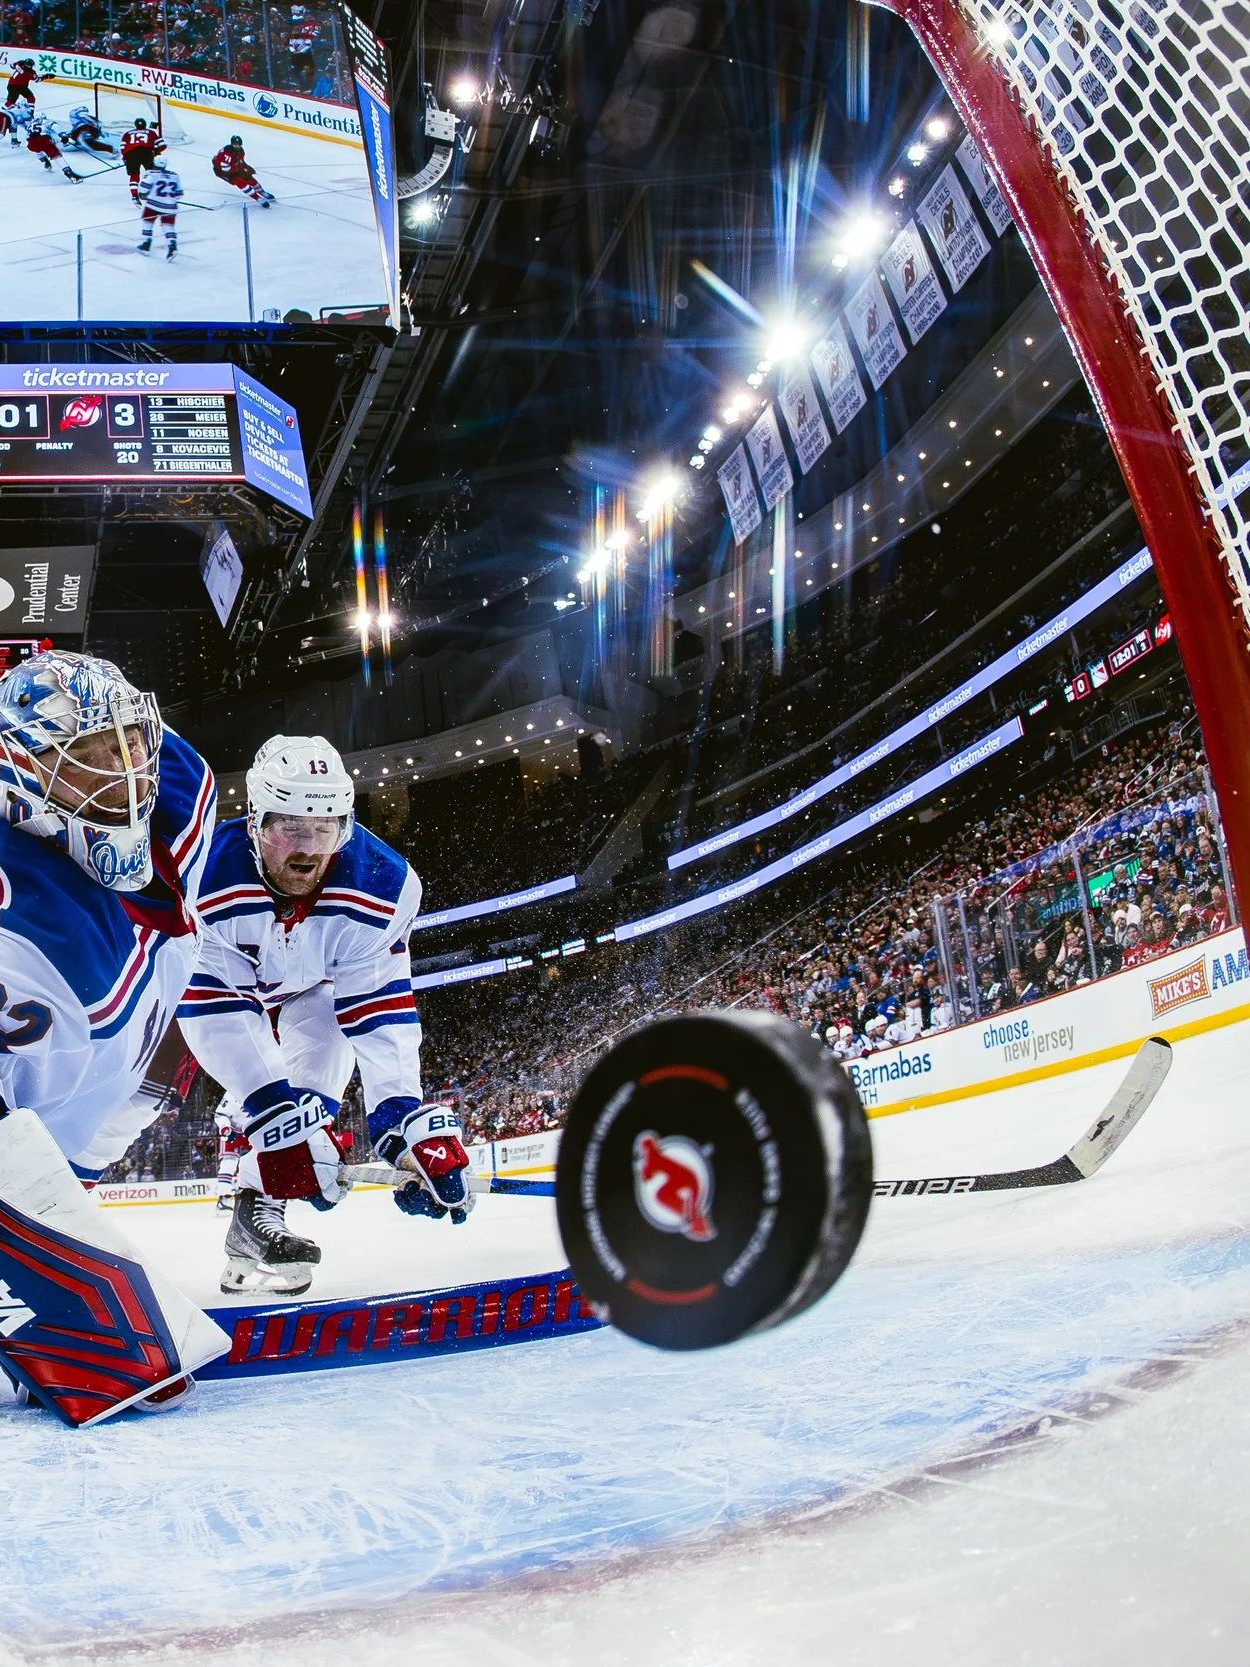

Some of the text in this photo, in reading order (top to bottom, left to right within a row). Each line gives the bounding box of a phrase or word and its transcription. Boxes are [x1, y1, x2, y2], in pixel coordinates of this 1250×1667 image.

[60, 58, 134, 85] Citizens
[283, 103, 362, 136] Prudentia
[129, 132, 148, 145] 13
[371, 102, 388, 200] ticketmaster
[154, 180, 177, 197] 23
[22, 368, 169, 387] ticketmaster
[150, 396, 225, 407] 13 HISCHIER
[239, 381, 282, 416] ticketmaster
[115, 403, 135, 428] 3
[195, 412, 227, 423] MEIER
[243, 409, 259, 426] BUY
[267, 424, 285, 444] SELL
[36, 442, 73, 450] PENALTY
[113, 442, 142, 450] SHOTS
[152, 428, 229, 438] 11 NOESEN
[116, 451, 139, 465] 20
[172, 444, 230, 455] KOVACEVIC
[246, 432, 289, 467] TICKETS AT
[154, 460, 232, 472] 71 SIEGENTHALER
[247, 444, 305, 488] TICKETMASTER
[1119, 552, 1152, 586] ticketm
[21, 562, 50, 624] Prudential
[54, 574, 81, 612] Center
[1016, 617, 1068, 661] ticketmaster
[1111, 645, 1136, 669] 12:01
[1077, 679, 1084, 693] 0
[928, 685, 973, 723] ticketmaster
[309, 760, 329, 775] 13
[850, 742, 890, 774] ticketmaster
[950, 736, 1001, 776] ticketmaster
[781, 790, 817, 818] ticketmaster
[869, 789, 914, 823] ticketmaster
[92, 836, 151, 887] Quic
[792, 838, 831, 866] ticketmaster
[498, 887, 546, 908] ticketmaster
[718, 878, 759, 903] ticketmaster
[443, 964, 495, 983] ticketmaster
[1156, 971, 1201, 1005] MIKE'S
[983, 1019, 1030, 1049] choose
[851, 1050, 932, 1089] Barnabas
[98, 1187, 158, 1200] verizon
[873, 1177, 975, 1196] AUER
[227, 1280, 597, 1365] WARRIOR
